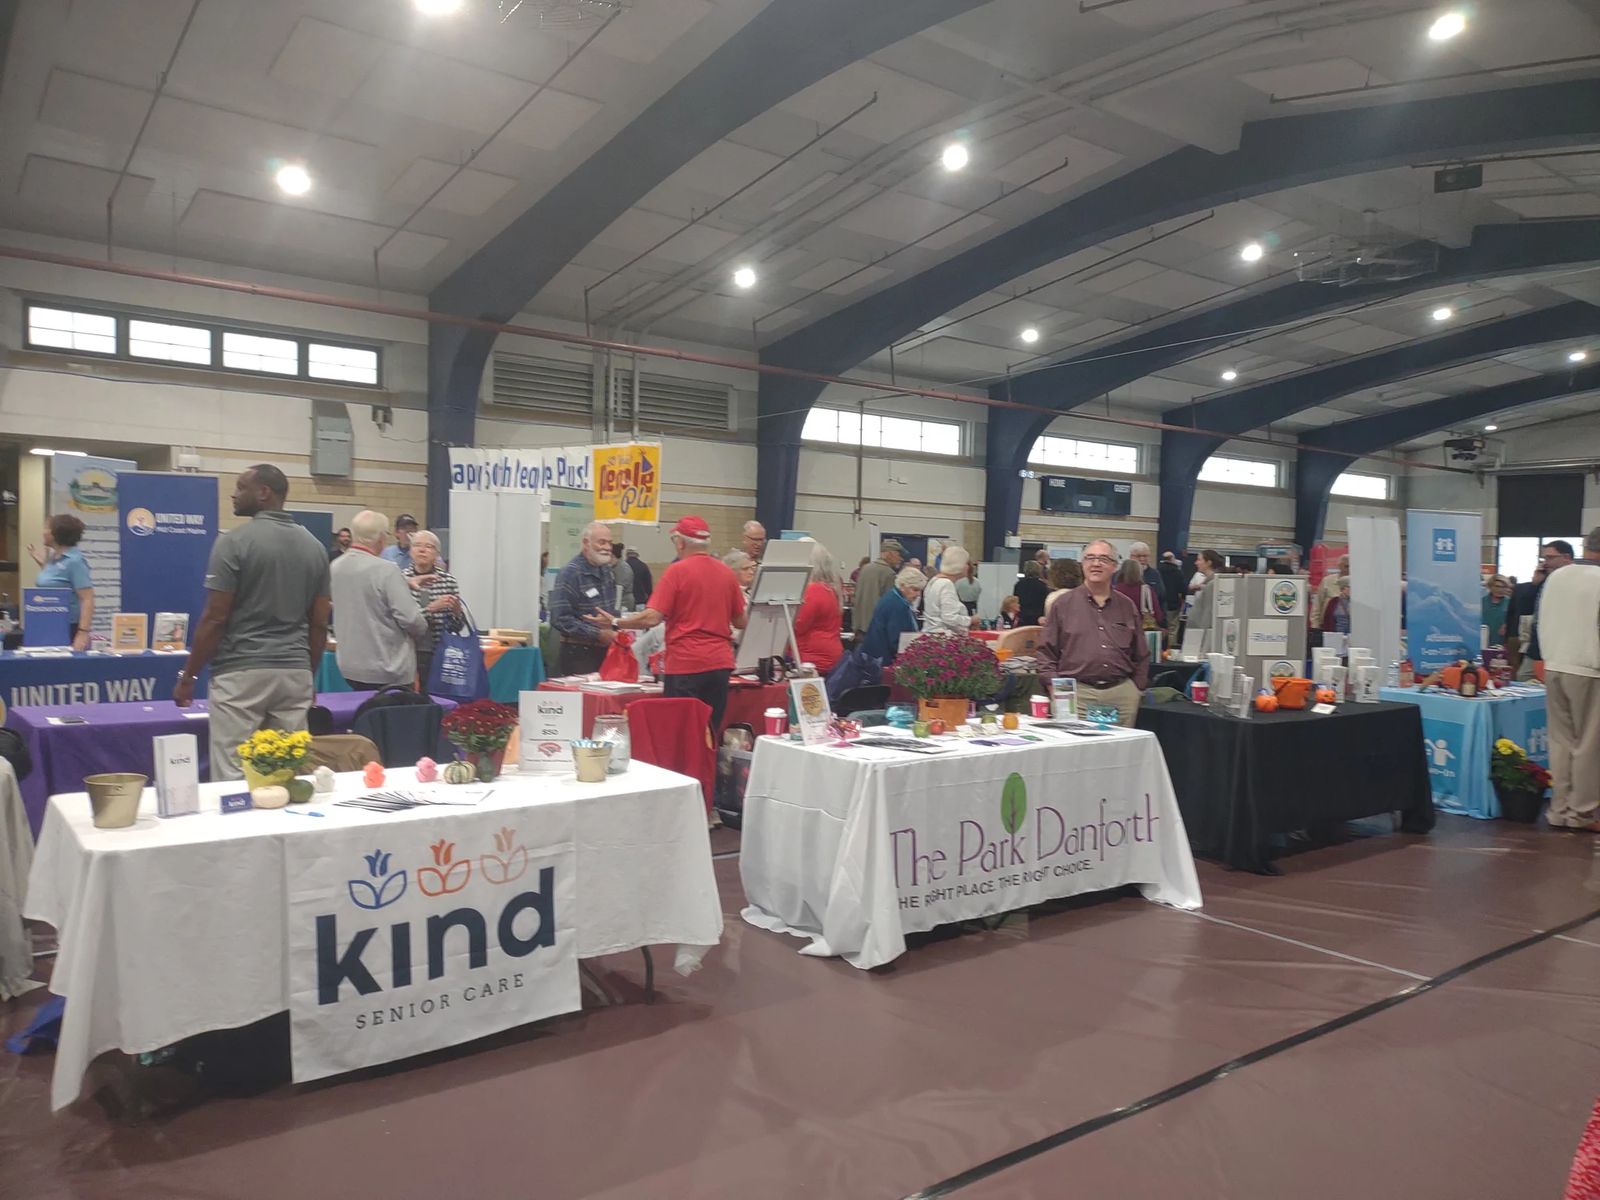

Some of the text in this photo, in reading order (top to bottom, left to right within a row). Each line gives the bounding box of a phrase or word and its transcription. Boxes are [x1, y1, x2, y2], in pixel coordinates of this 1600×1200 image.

[155, 513, 204, 525] UNITED WAY
[11, 677, 156, 707] UNITED WAY
[537, 705, 564, 715] kind
[889, 827, 948, 889] The
[957, 819, 1026, 877] Park
[315, 866, 556, 1006] kind
[355, 973, 525, 1030] SENIOR CARE
